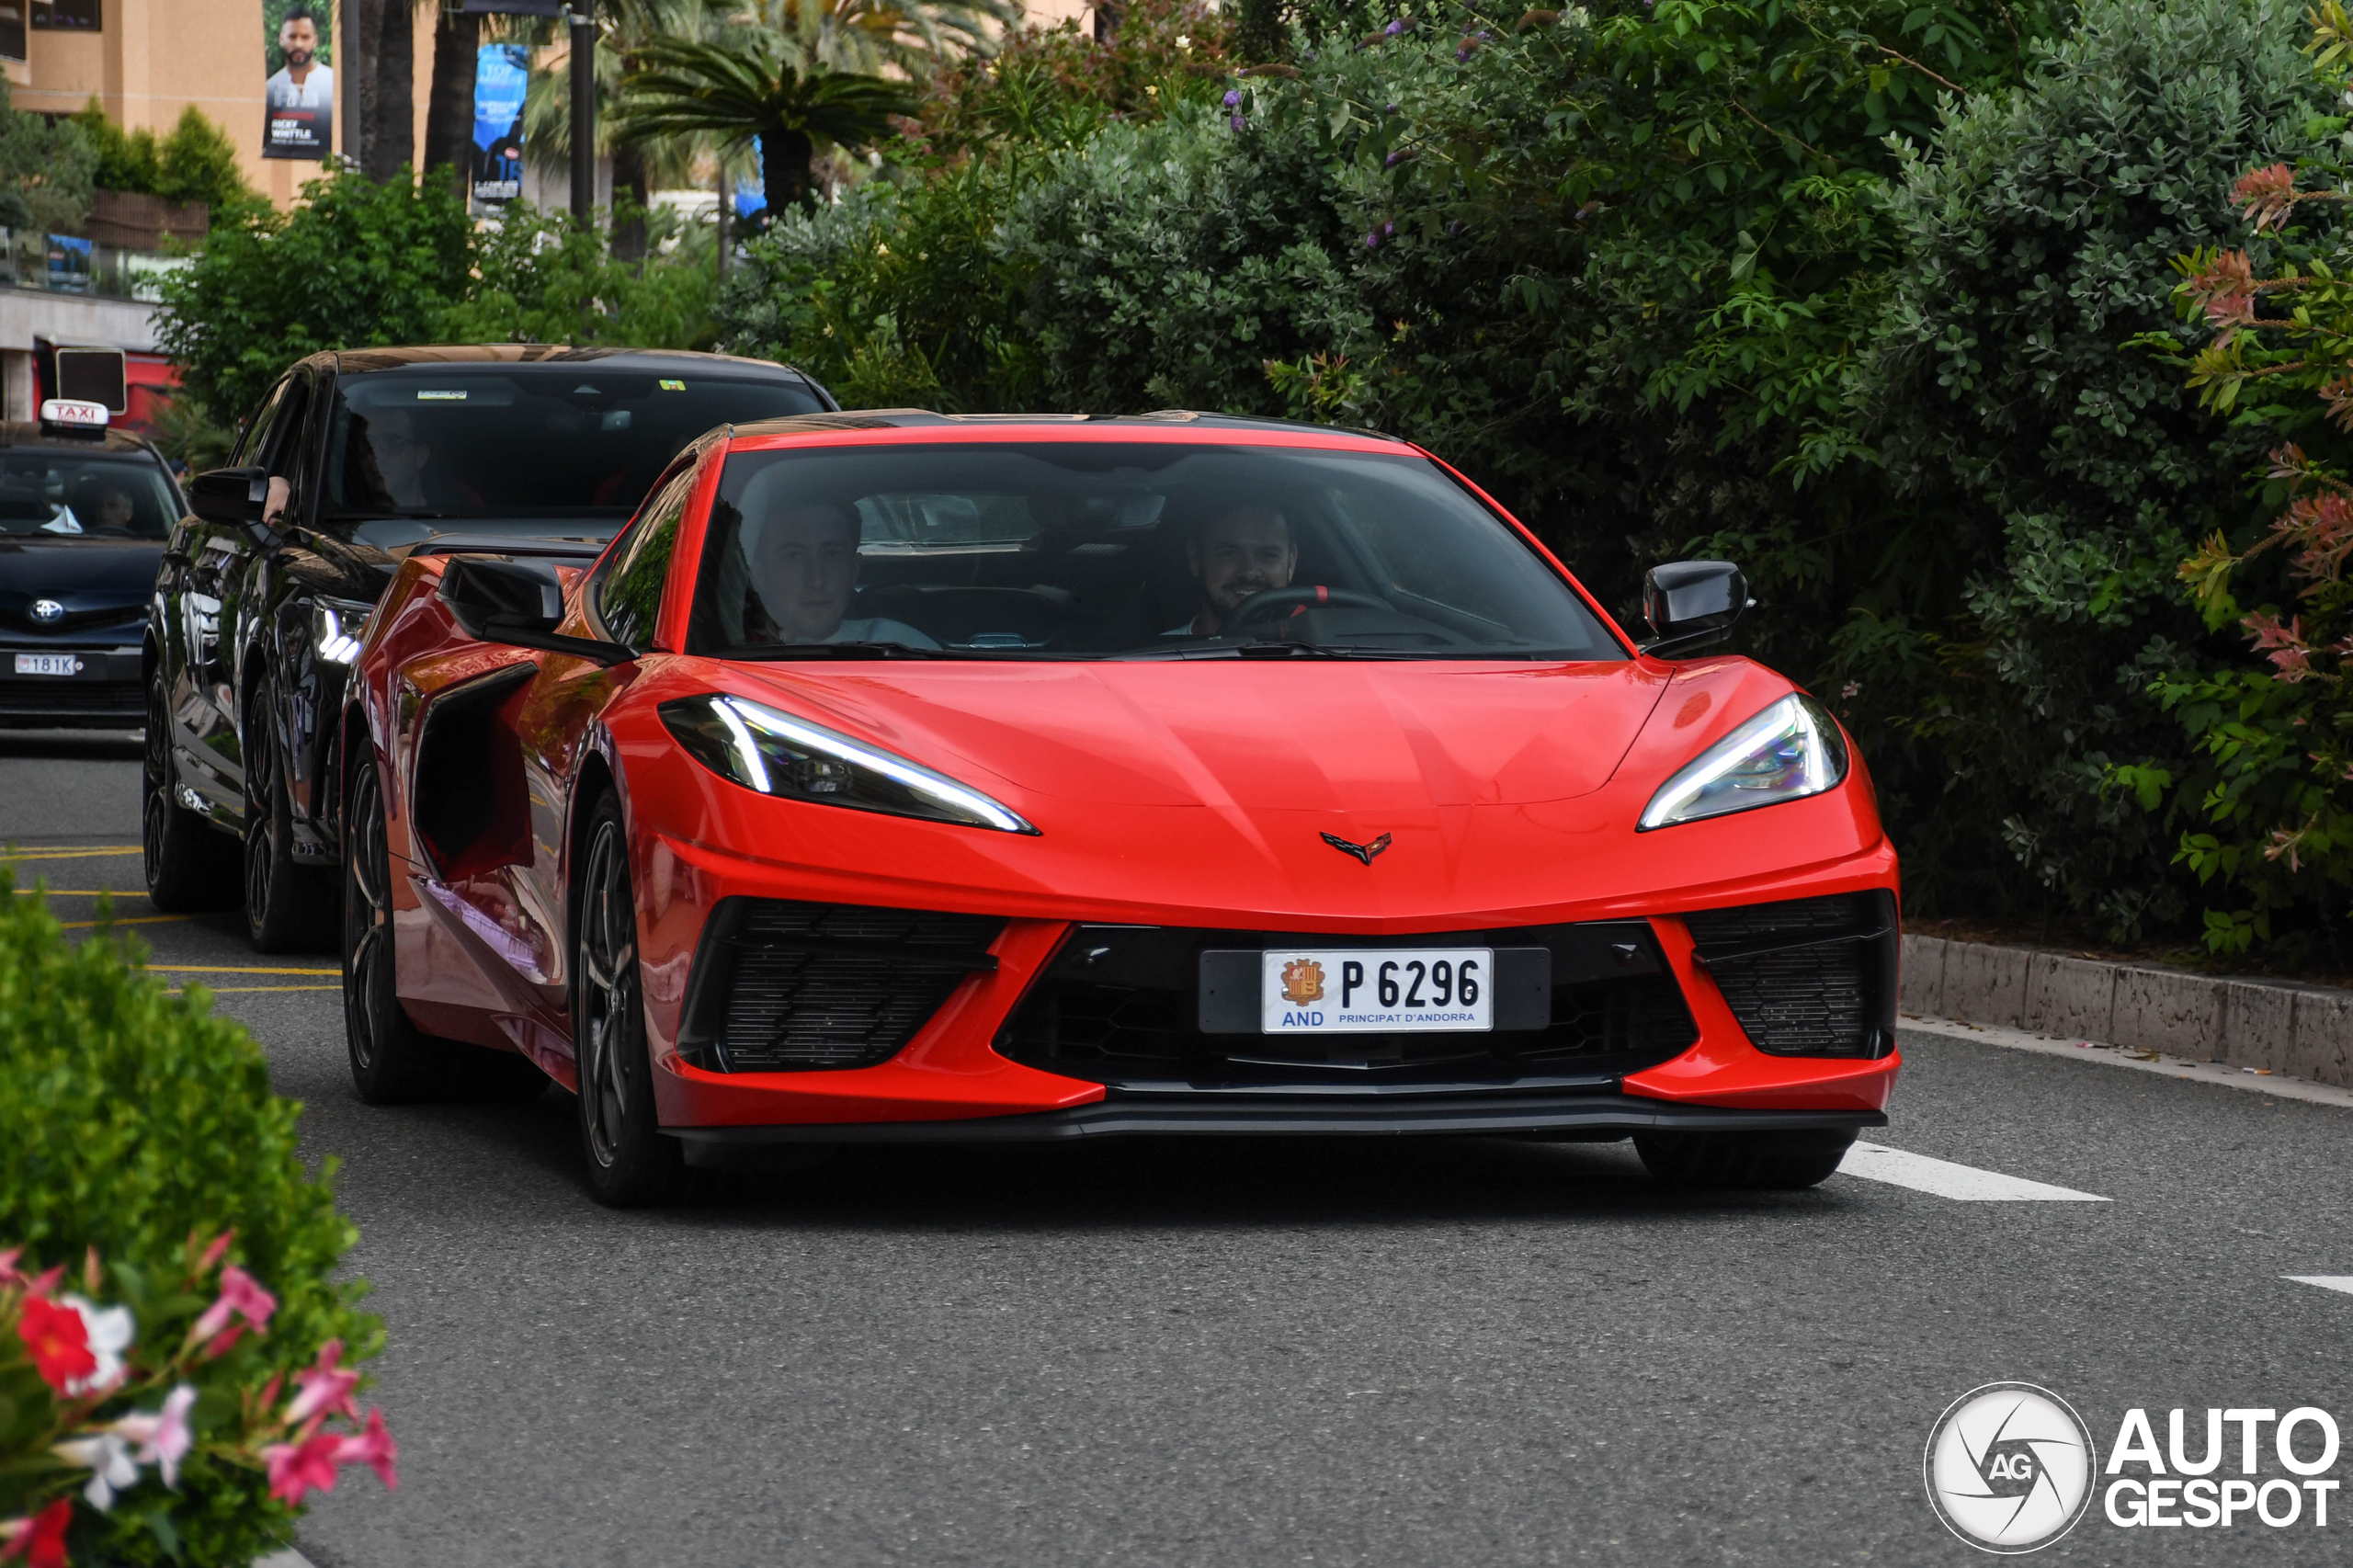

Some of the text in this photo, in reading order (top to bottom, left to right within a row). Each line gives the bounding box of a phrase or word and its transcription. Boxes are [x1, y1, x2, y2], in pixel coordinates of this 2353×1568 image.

[56, 405, 95, 419] TAXI
[33, 658, 72, 672] 181K
[1342, 960, 1479, 1008] P 6296
[1282, 1011, 1475, 1027] AND PRINCIPAT D'ANDORRA
